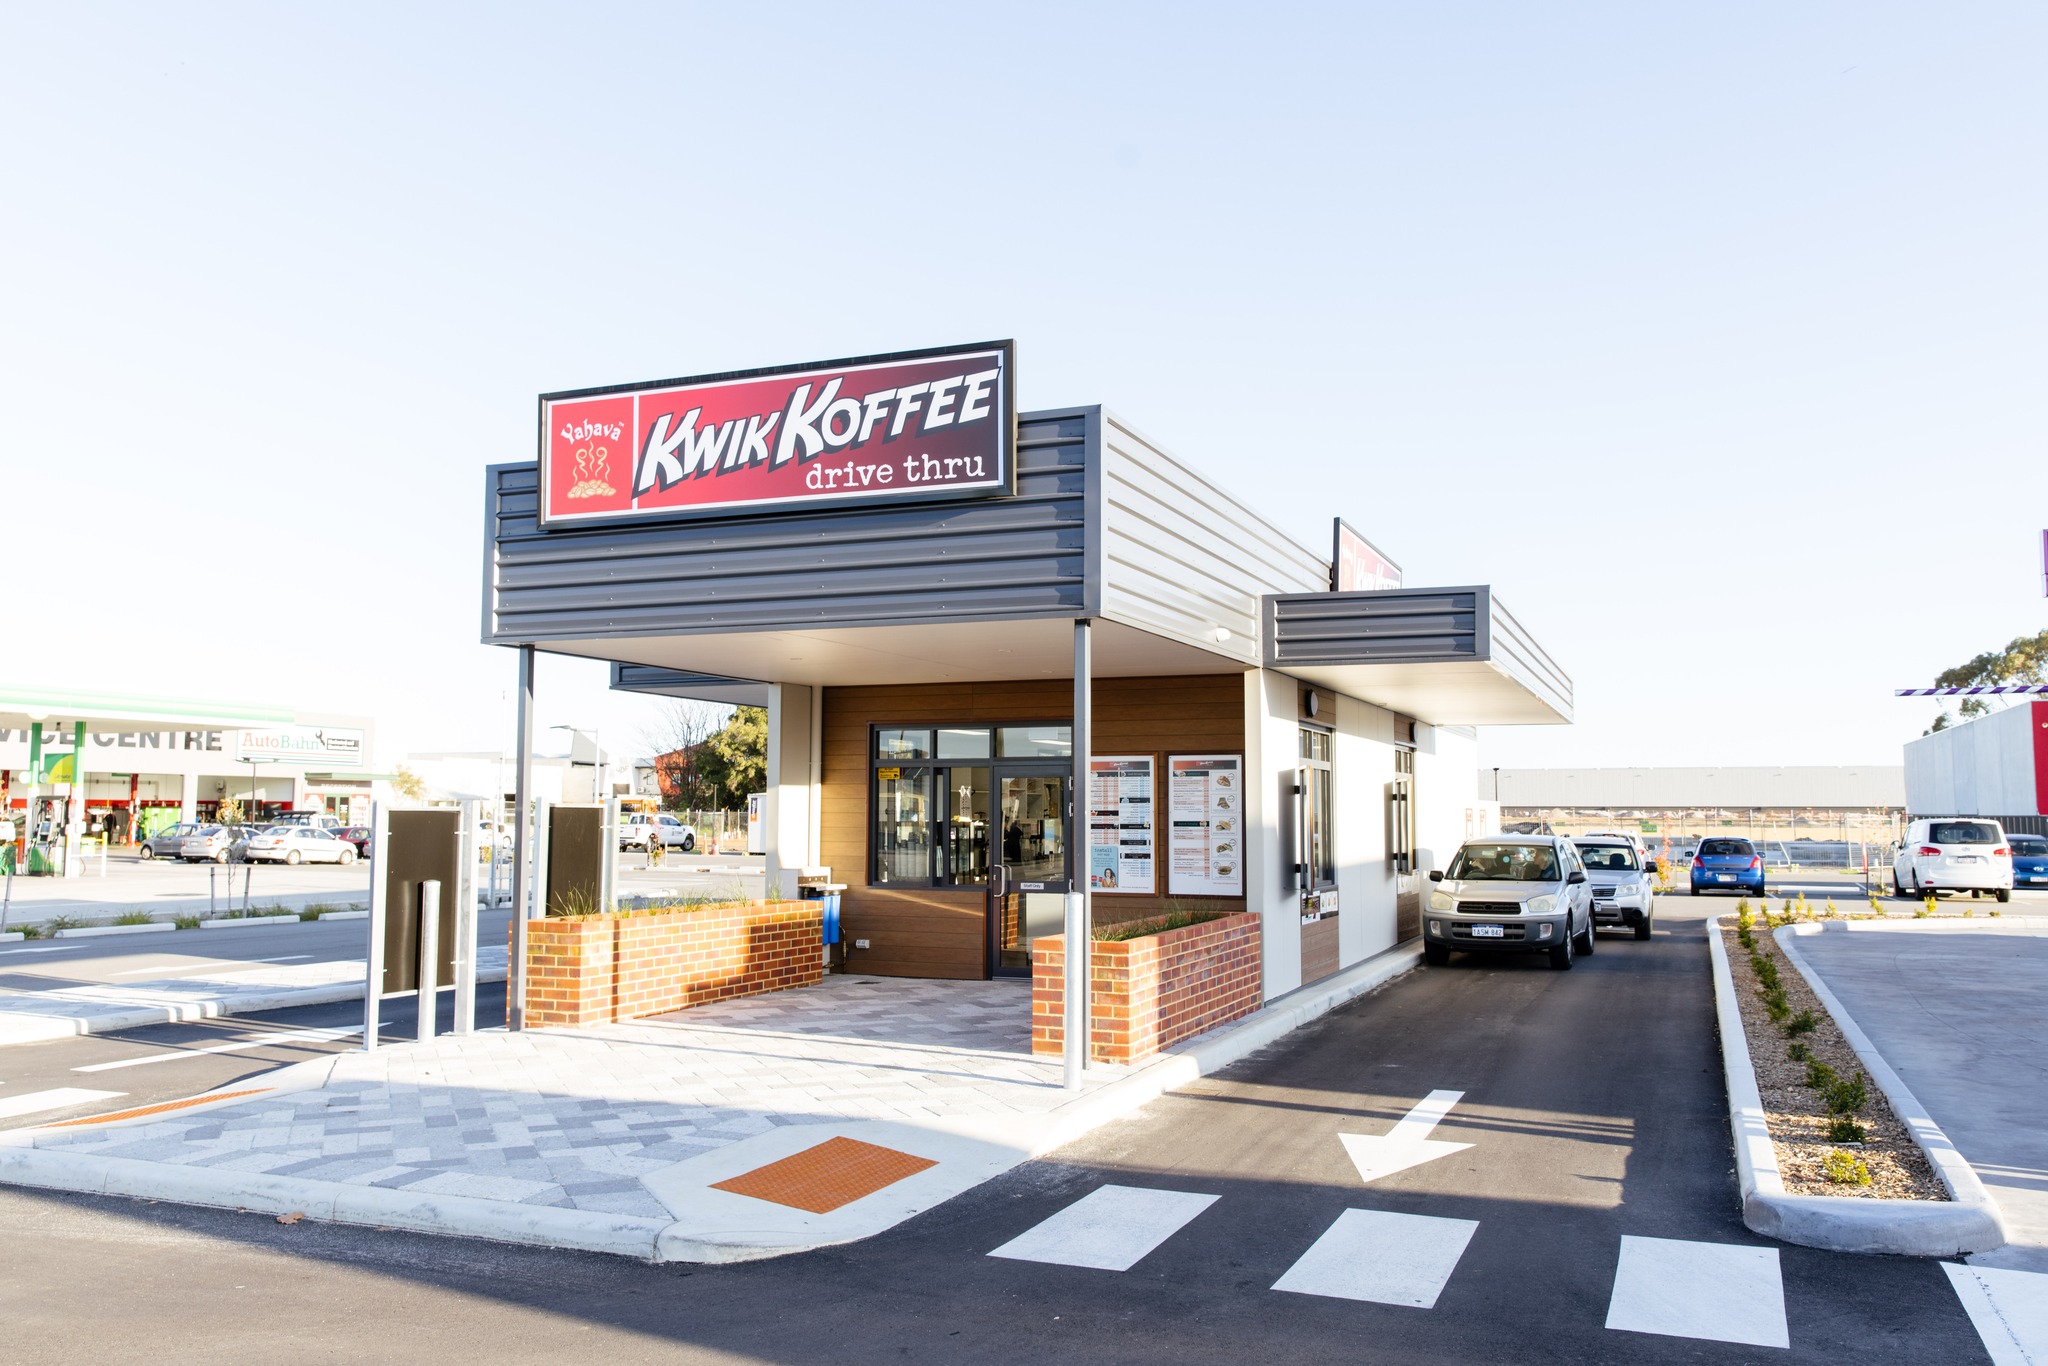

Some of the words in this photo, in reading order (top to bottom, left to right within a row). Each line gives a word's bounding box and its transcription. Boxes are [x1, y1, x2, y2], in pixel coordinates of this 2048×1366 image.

[561, 418, 621, 445] Yahava
[769, 366, 1002, 471] KOFFEE
[806, 462, 893, 490] drive
[903, 454, 986, 483] thru
[93, 730, 222, 751] CENTRE
[242, 732, 319, 750] AutoBahn
